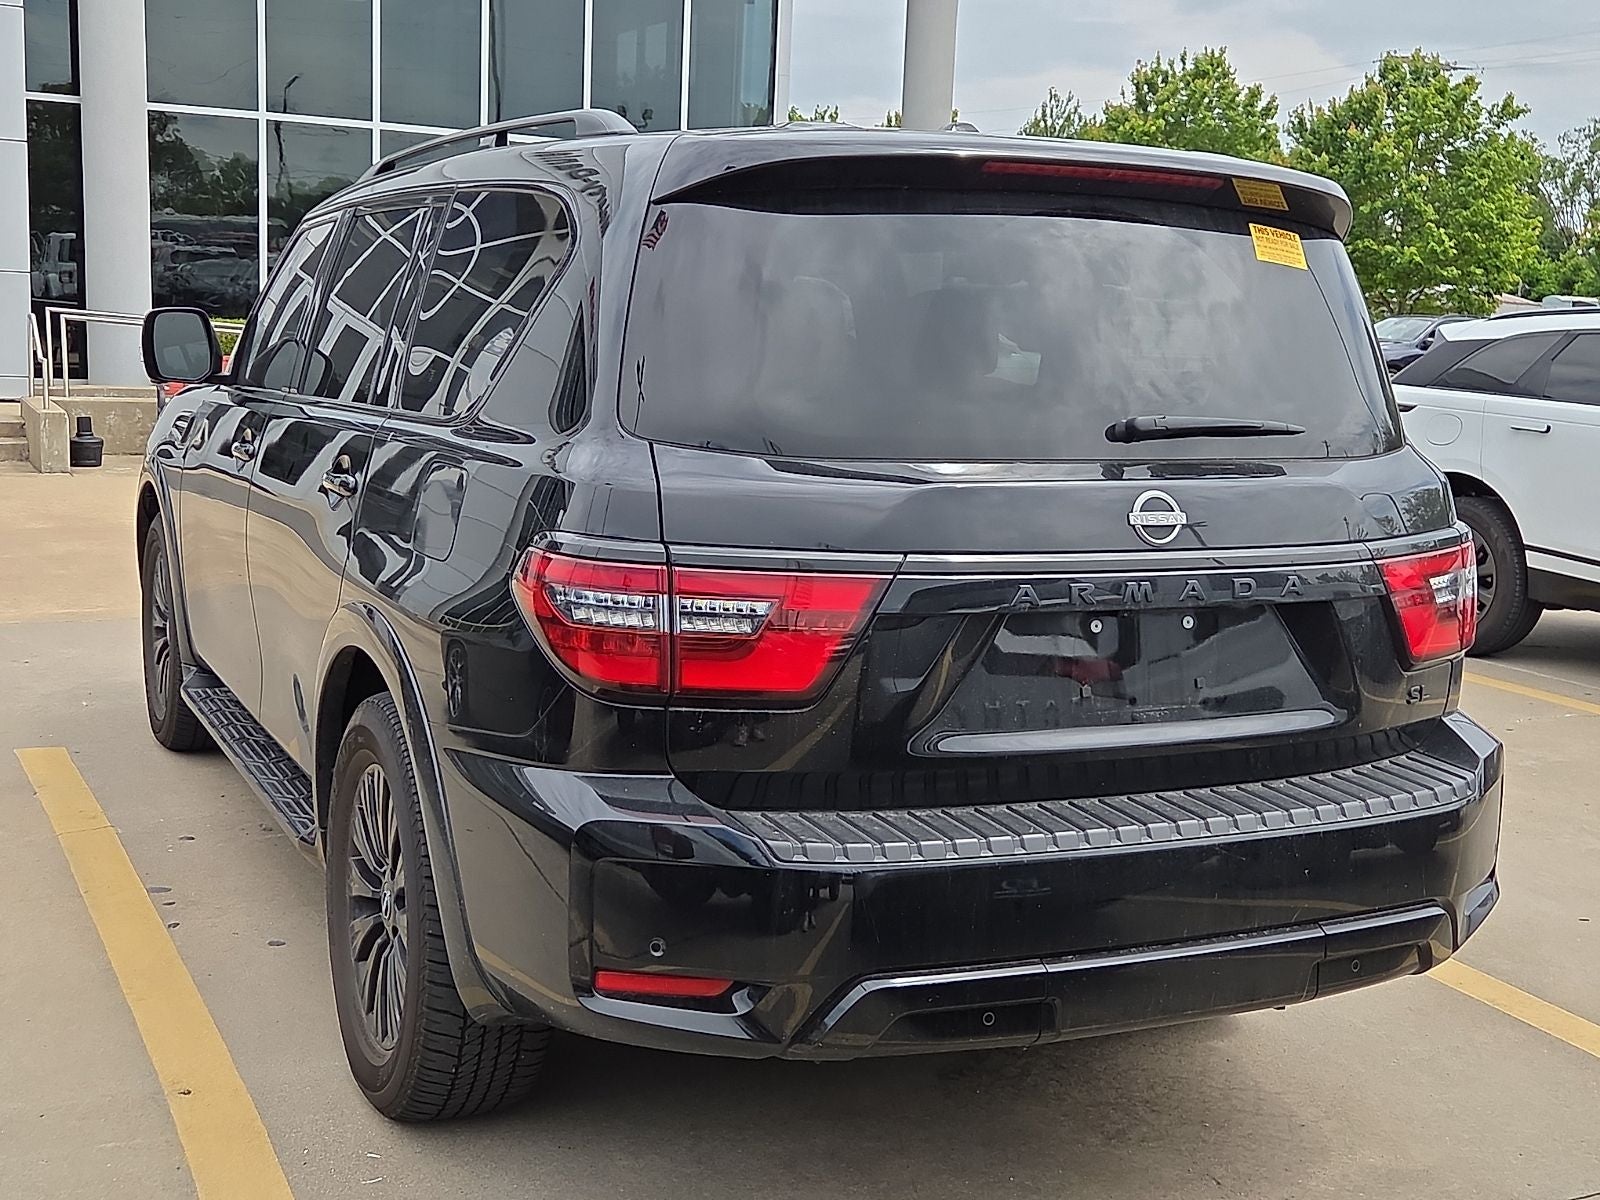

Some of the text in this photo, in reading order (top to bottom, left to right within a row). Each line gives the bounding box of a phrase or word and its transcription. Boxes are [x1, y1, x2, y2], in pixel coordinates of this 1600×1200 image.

[1252, 225, 1298, 243] THIS VEHICLE
[1130, 513, 1186, 525] NISSAN
[1010, 575, 1306, 608] ARMADA
[1405, 684, 1431, 705] SL
